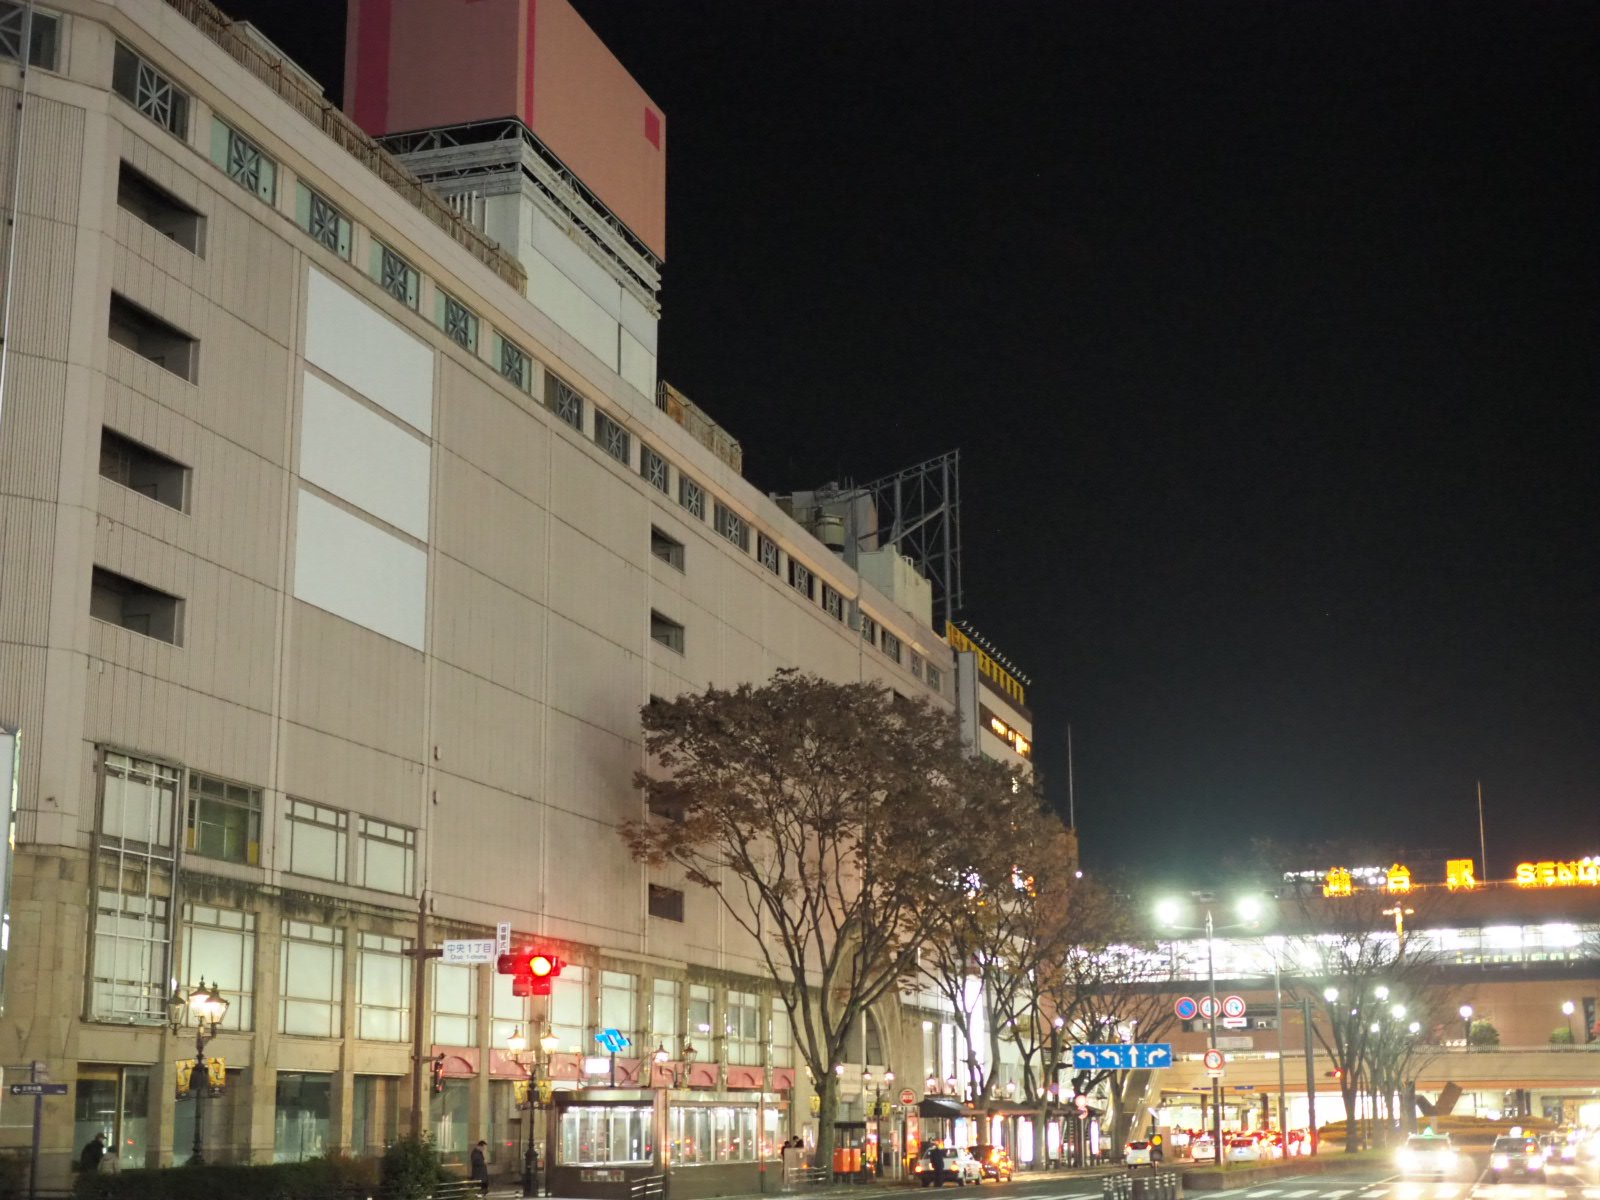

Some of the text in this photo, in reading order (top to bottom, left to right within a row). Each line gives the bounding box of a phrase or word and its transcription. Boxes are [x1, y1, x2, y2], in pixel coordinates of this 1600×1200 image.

[1516, 860, 1600, 886] SEND
[447, 943, 492, 954] 中央1丁目
